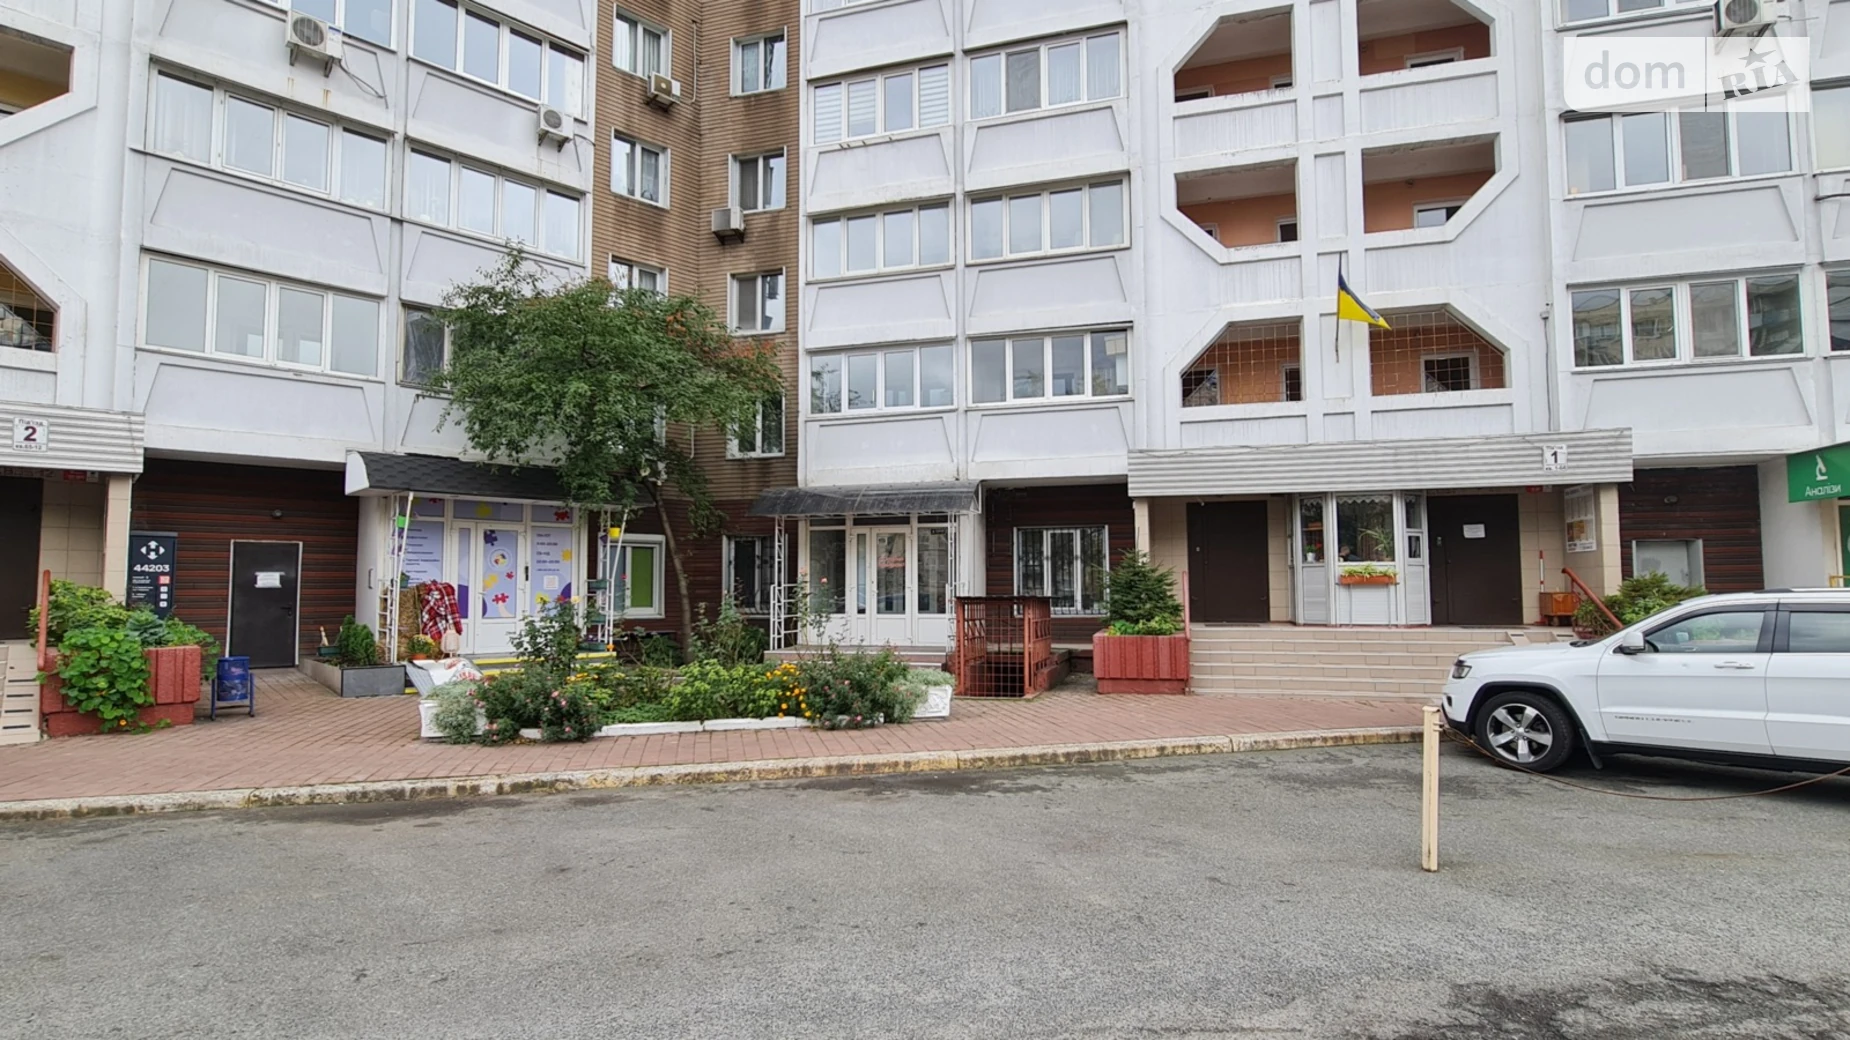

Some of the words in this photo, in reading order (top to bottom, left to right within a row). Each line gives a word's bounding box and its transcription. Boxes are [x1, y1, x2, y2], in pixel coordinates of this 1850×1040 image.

[23, 425, 37, 442] 2
[1551, 450, 1558, 464] 1
[1804, 483, 1842, 497] Аналізи
[133, 564, 170, 572] 44203
